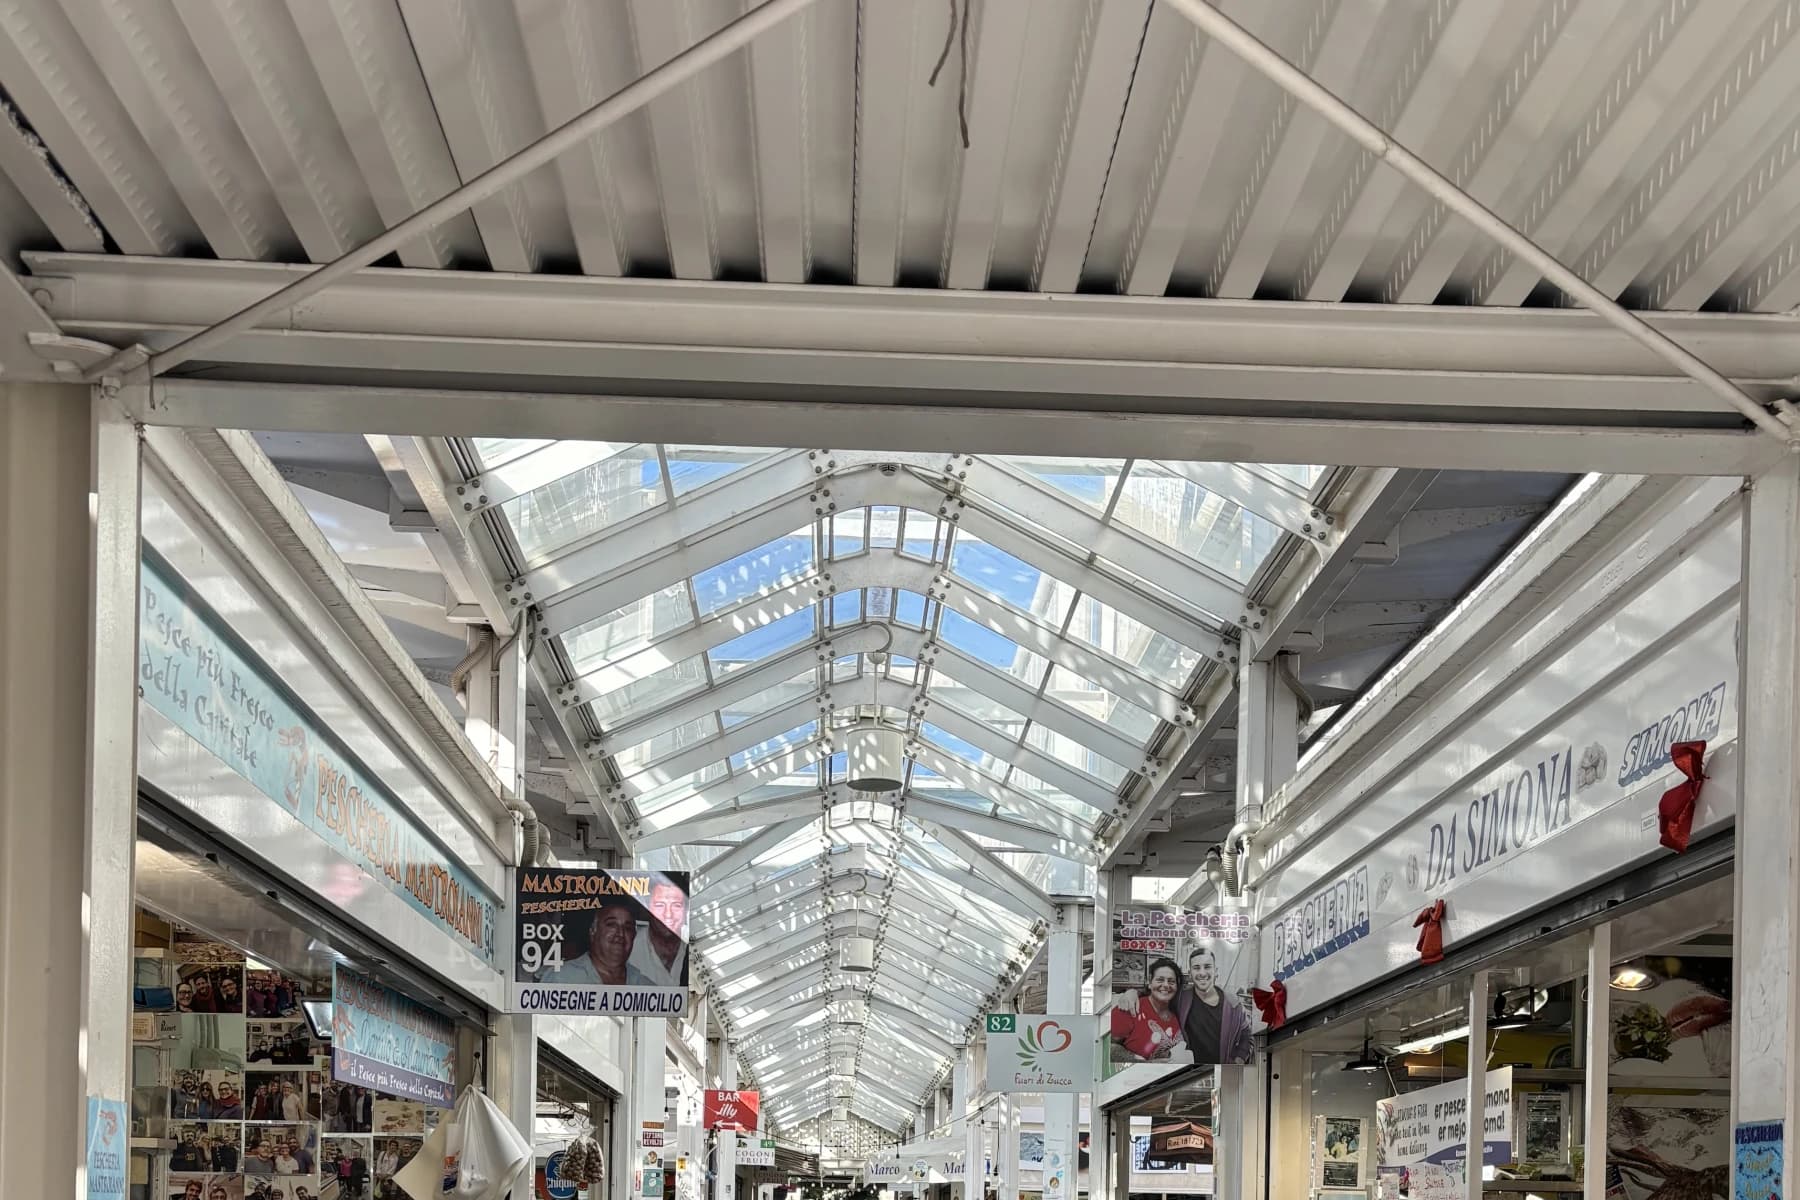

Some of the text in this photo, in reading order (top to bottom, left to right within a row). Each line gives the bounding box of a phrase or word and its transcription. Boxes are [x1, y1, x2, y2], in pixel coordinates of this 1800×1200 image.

[142, 640, 188, 713] della
[231, 670, 275, 732] Fresco
[1618, 681, 1727, 787] SIMONA
[1424, 746, 1573, 893] DA SIMONA
[316, 754, 484, 949] PESCHERIA MASTROIANNI
[521, 872, 651, 897] MASTROIANNI
[520, 898, 602, 915] PESCHERIA
[1121, 910, 1250, 928] La Pescheria
[1272, 864, 1370, 982] PESCHERIA
[522, 924, 564, 940] BOX
[1136, 927, 1186, 938] Simona
[1188, 929, 1198, 938] e
[1199, 928, 1249, 939] Daniele
[521, 941, 564, 973] 94
[520, 989, 682, 1013] CONSEGNE A DOMICILIO
[990, 1017, 1012, 1031] 82
[350, 1059, 357, 1077] il
[358, 1064, 375, 1082] Pesce
[376, 1071, 388, 1087] più
[389, 1074, 408, 1093] Fresco
[1036, 1072, 1044, 1085] di
[1046, 1072, 1072, 1085] Zucca
[718, 1092, 740, 1102] BAR
[719, 1104, 738, 1119] illy
[1434, 1104, 1443, 1119] er
[1443, 1097, 1466, 1122] pesce
[1438, 1110, 1505, 1142] er mejo oma!
[1735, 1124, 1783, 1144] PESCHERIA
[869, 1163, 900, 1175] Marco
[943, 1161, 965, 1174] Mat
